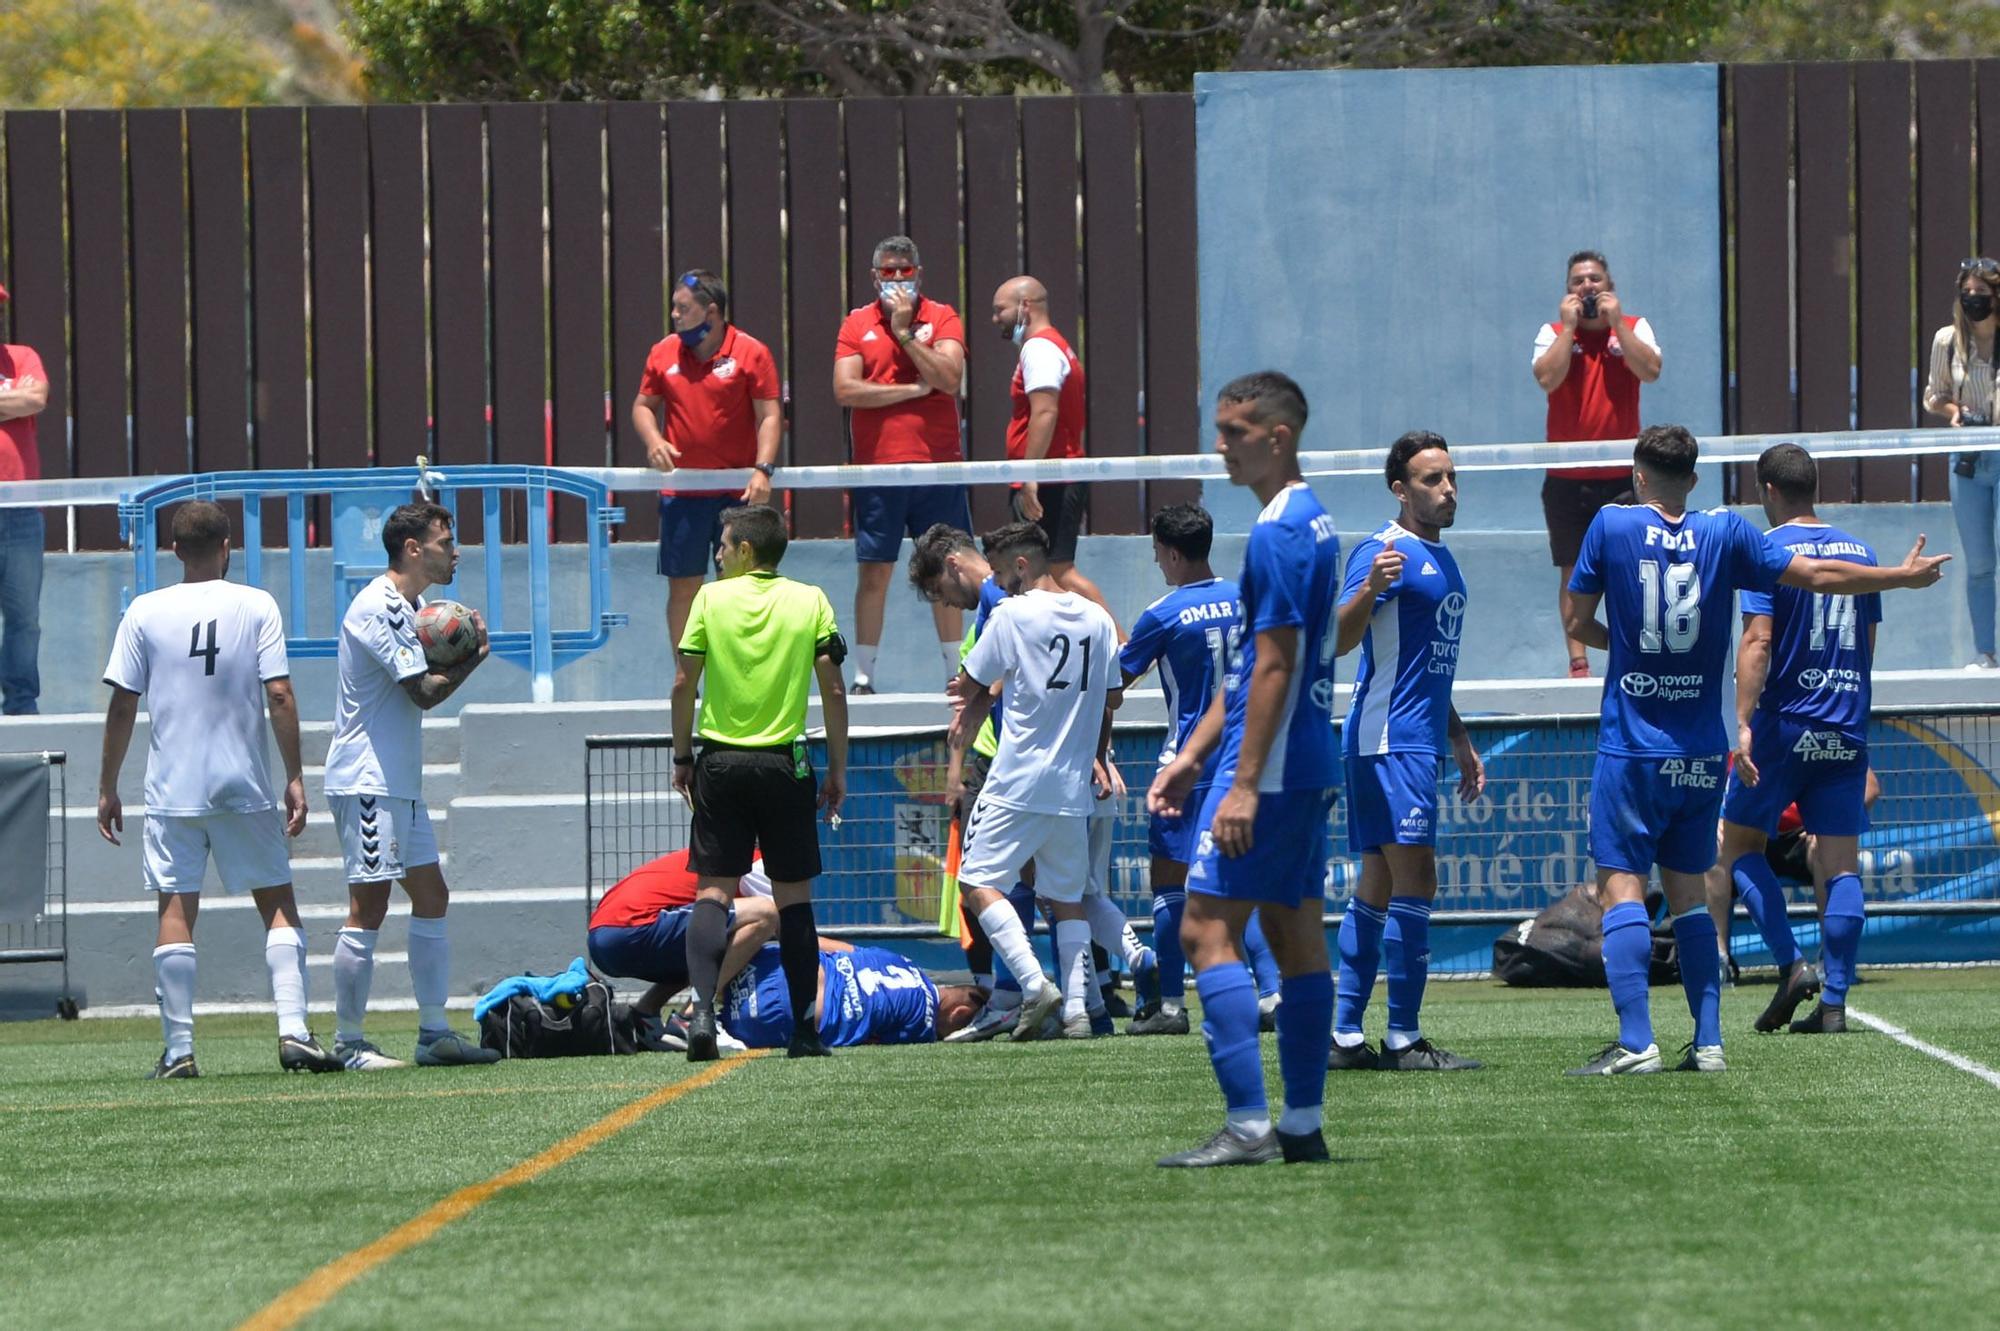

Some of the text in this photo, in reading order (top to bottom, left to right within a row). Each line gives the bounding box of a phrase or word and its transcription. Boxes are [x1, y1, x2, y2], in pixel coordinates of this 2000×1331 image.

[1179, 601, 1232, 624] OMAR
[1639, 560, 1701, 653] 18
[1809, 592, 1857, 650] 14
[189, 618, 221, 676] 4
[1046, 633, 1091, 691] 21
[1658, 675, 1703, 687] TOYOTA
[1657, 687, 1700, 701] Alypesa
[1827, 739, 1845, 750] EL
[1811, 749, 1858, 761] CRUCE
[1691, 761, 1707, 775] EL
[1678, 773, 1718, 788] CRUCE
[1506, 778, 1555, 822] de
